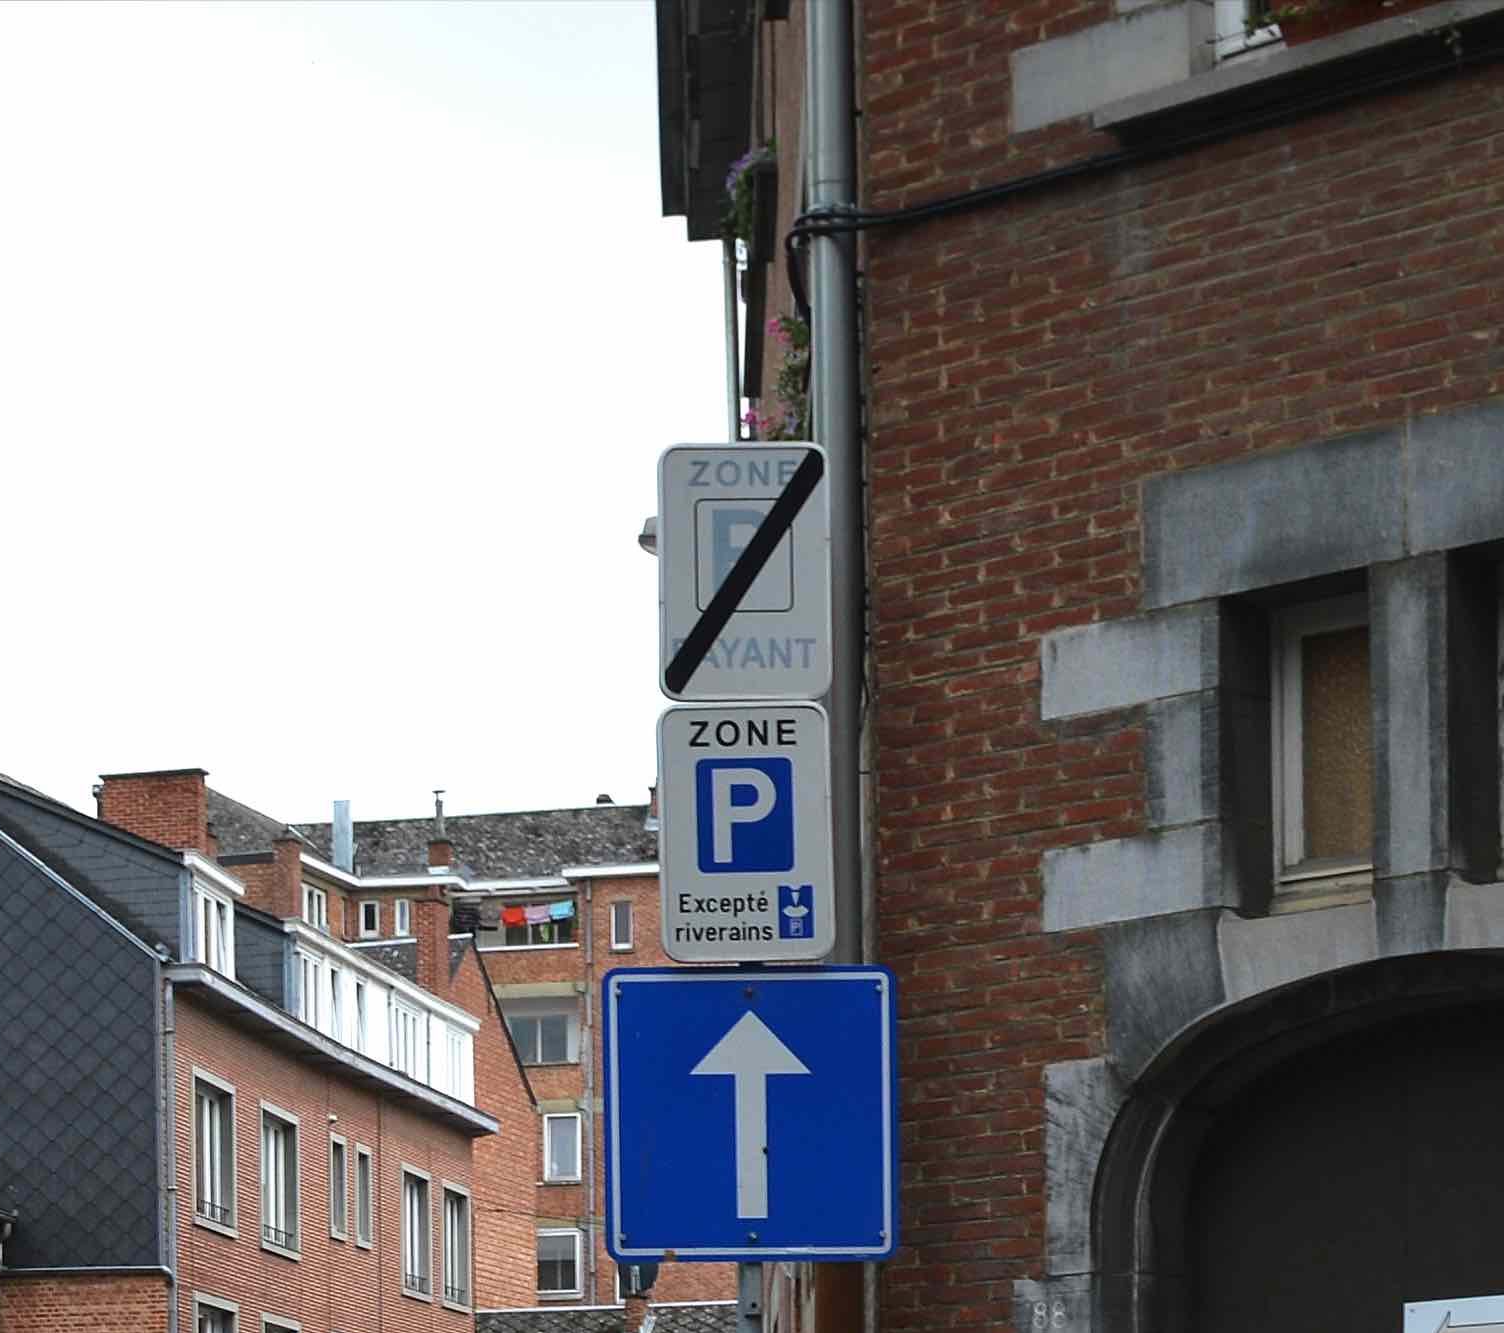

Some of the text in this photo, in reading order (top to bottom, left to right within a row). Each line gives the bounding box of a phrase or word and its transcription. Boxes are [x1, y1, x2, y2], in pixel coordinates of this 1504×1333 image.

[688, 460, 798, 487] ZONE
[688, 719, 797, 748] ZONE
[711, 767, 777, 864] P
[678, 890, 769, 917] Excepté
[675, 922, 774, 943] riverains
